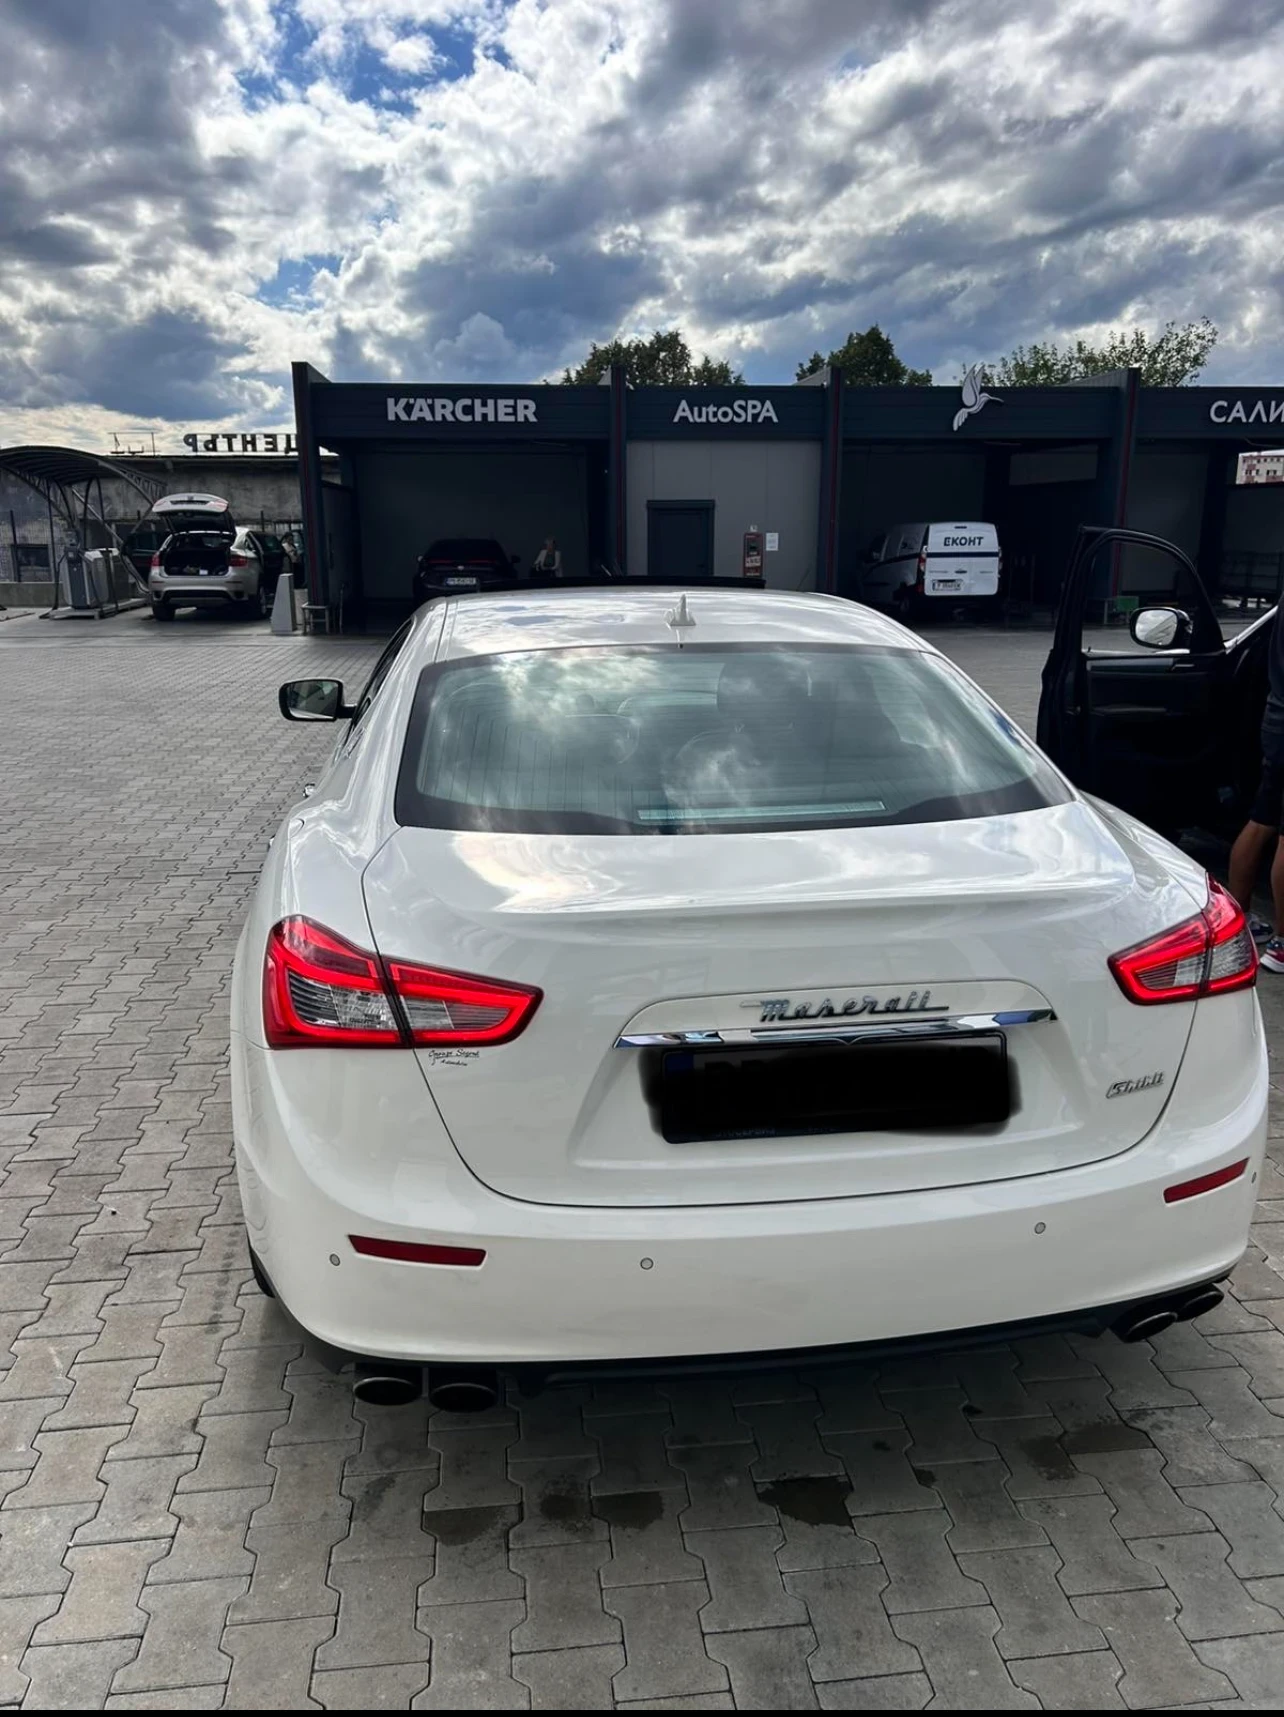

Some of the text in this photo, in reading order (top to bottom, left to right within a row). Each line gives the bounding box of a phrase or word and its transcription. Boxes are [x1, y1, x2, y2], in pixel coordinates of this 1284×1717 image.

[386, 397, 538, 422] KÄRCHER
[672, 399, 779, 423] AutoSPA
[943, 536, 984, 547] ЕКОНТ
